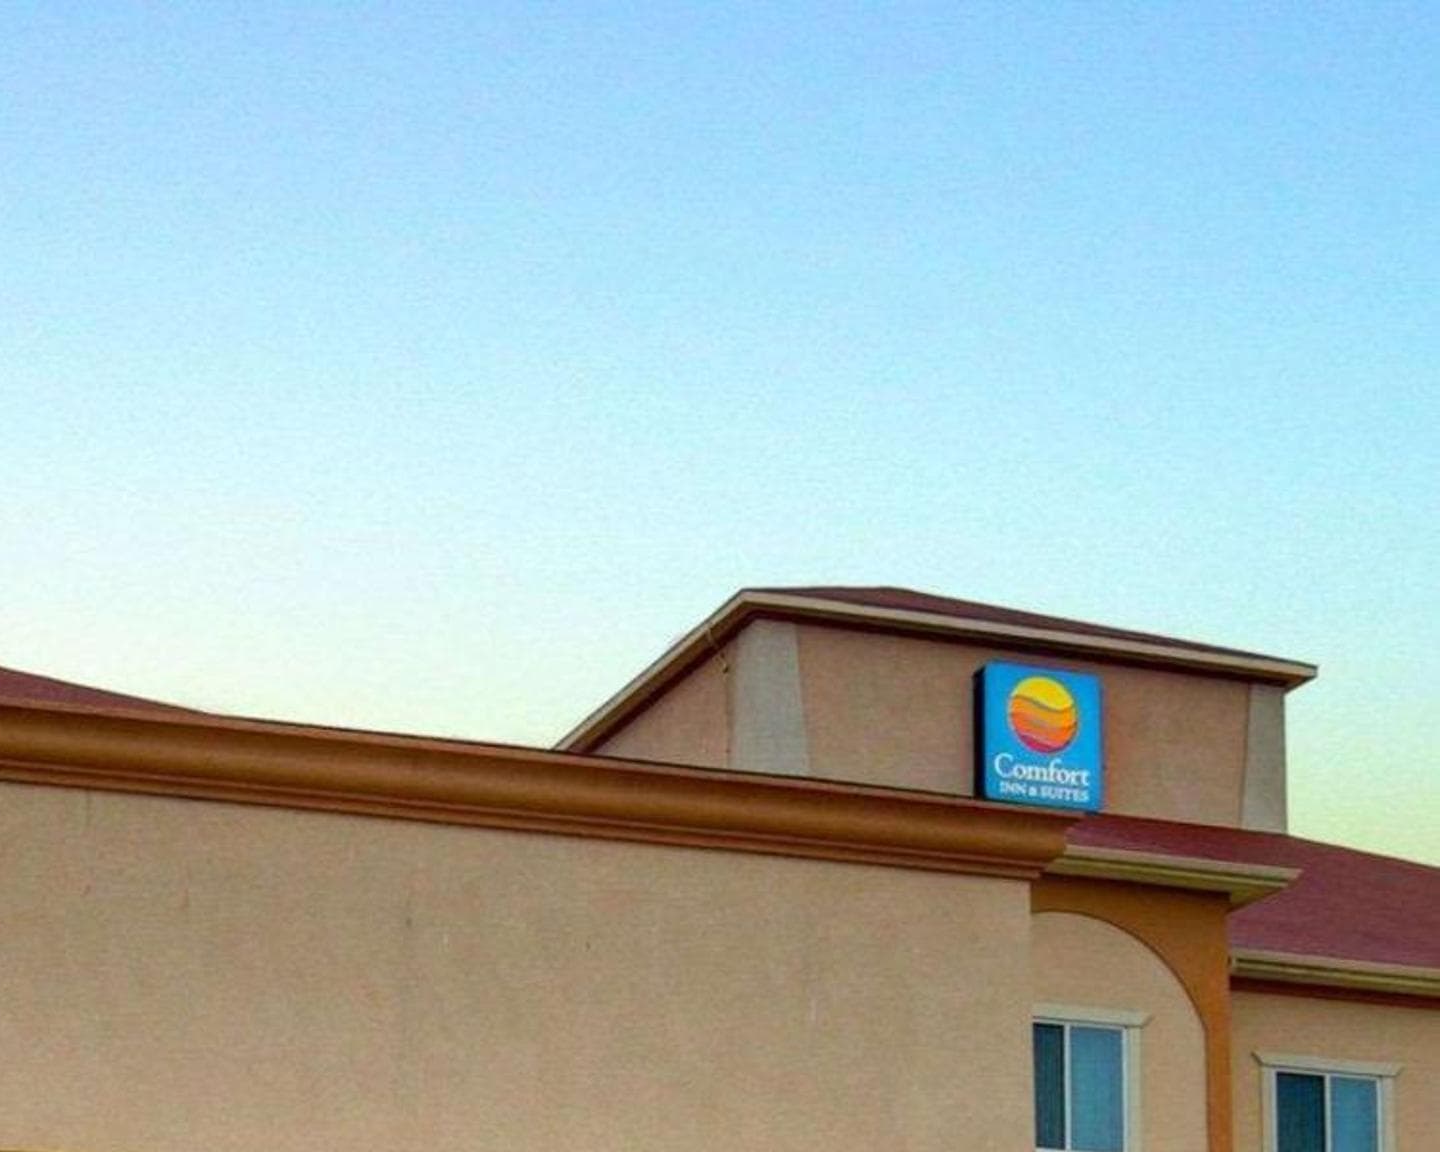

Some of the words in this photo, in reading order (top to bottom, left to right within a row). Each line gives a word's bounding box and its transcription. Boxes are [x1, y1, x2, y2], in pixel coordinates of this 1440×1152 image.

[994, 753, 1090, 786] Comfort
[1000, 781, 1027, 795] INN
[1040, 786, 1090, 802] SUITES
